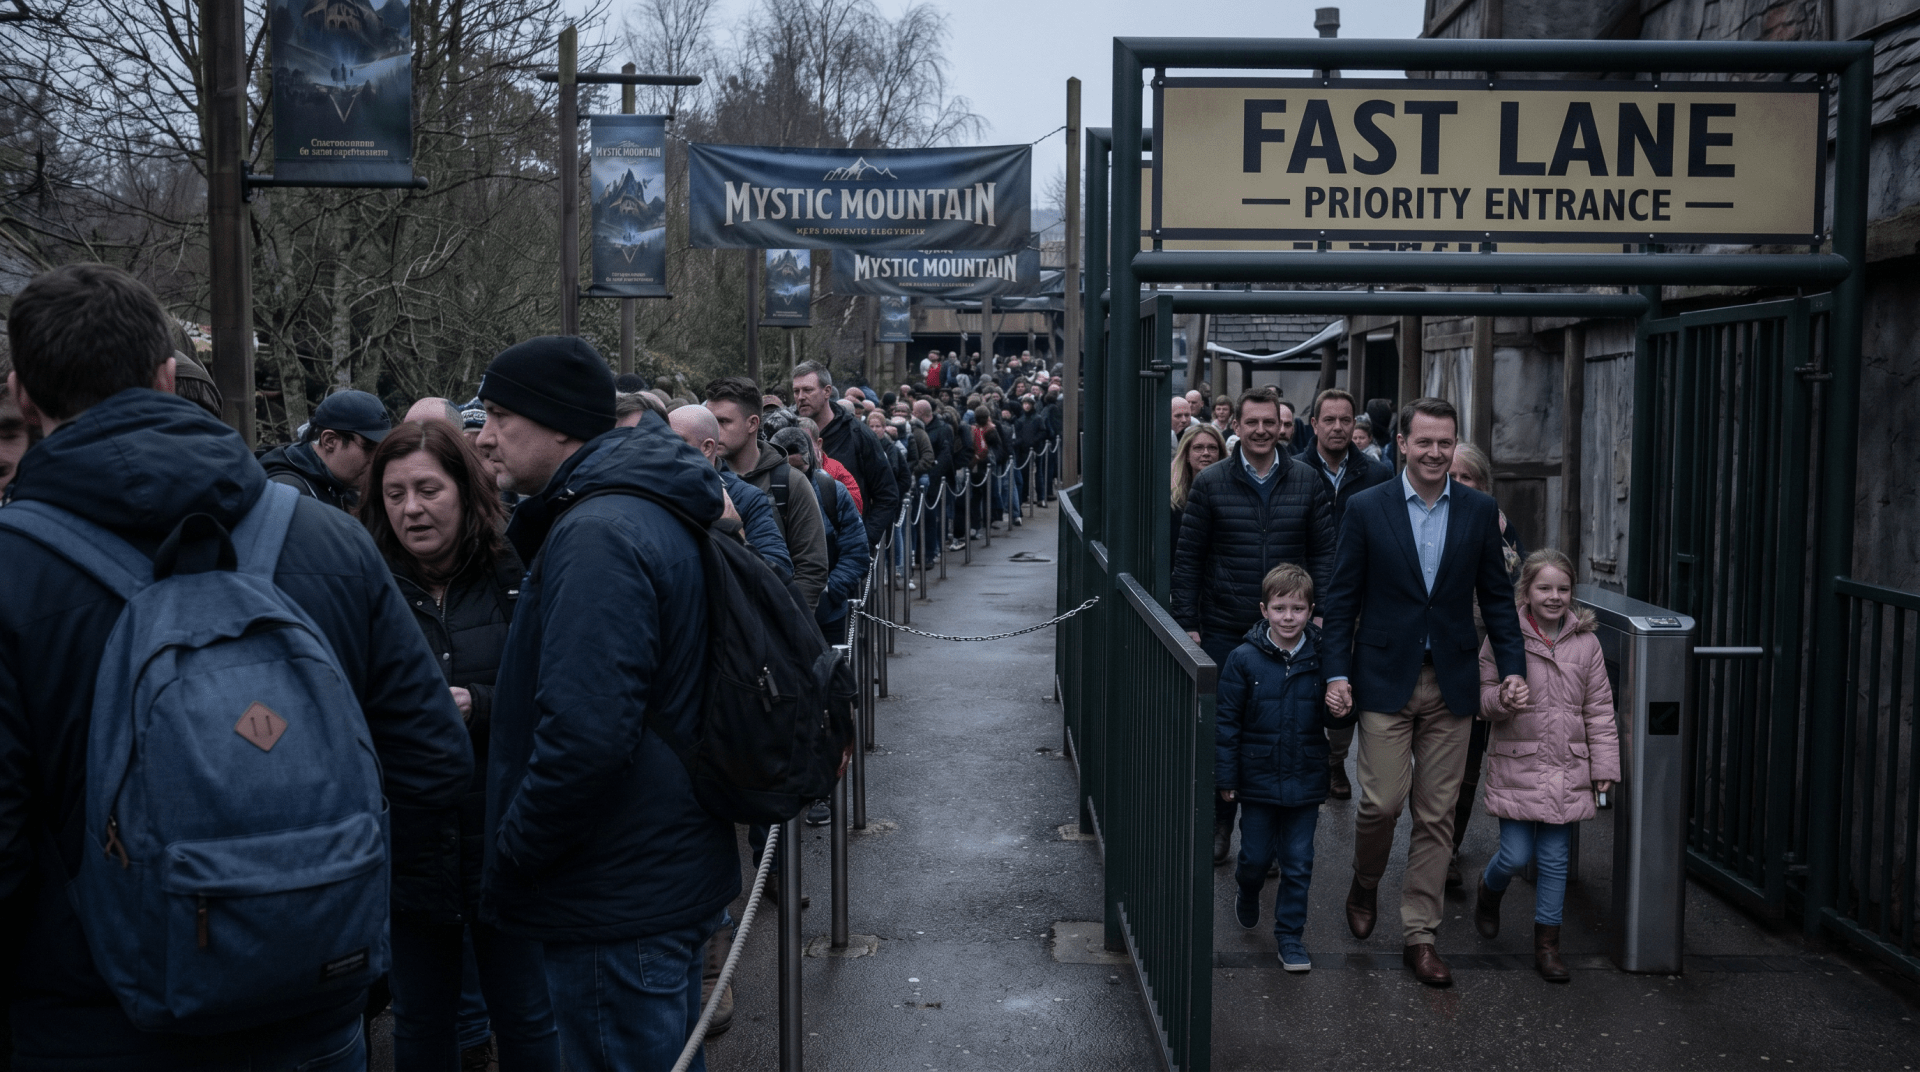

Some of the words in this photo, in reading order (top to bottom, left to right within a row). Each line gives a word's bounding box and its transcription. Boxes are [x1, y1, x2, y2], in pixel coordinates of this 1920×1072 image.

[596, 147, 623, 158] MYSTIC
[1242, 98, 1459, 176] FAST
[1498, 101, 1737, 178] LANE
[723, 181, 833, 226] MYSTIC
[839, 182, 997, 227] MOUNTAIN
[1304, 186, 1472, 220] PRIORITY
[1485, 187, 1672, 222] ENTRANCE
[854, 253, 919, 282] MYSTIC
[922, 254, 1017, 283] MOUNTAIN
